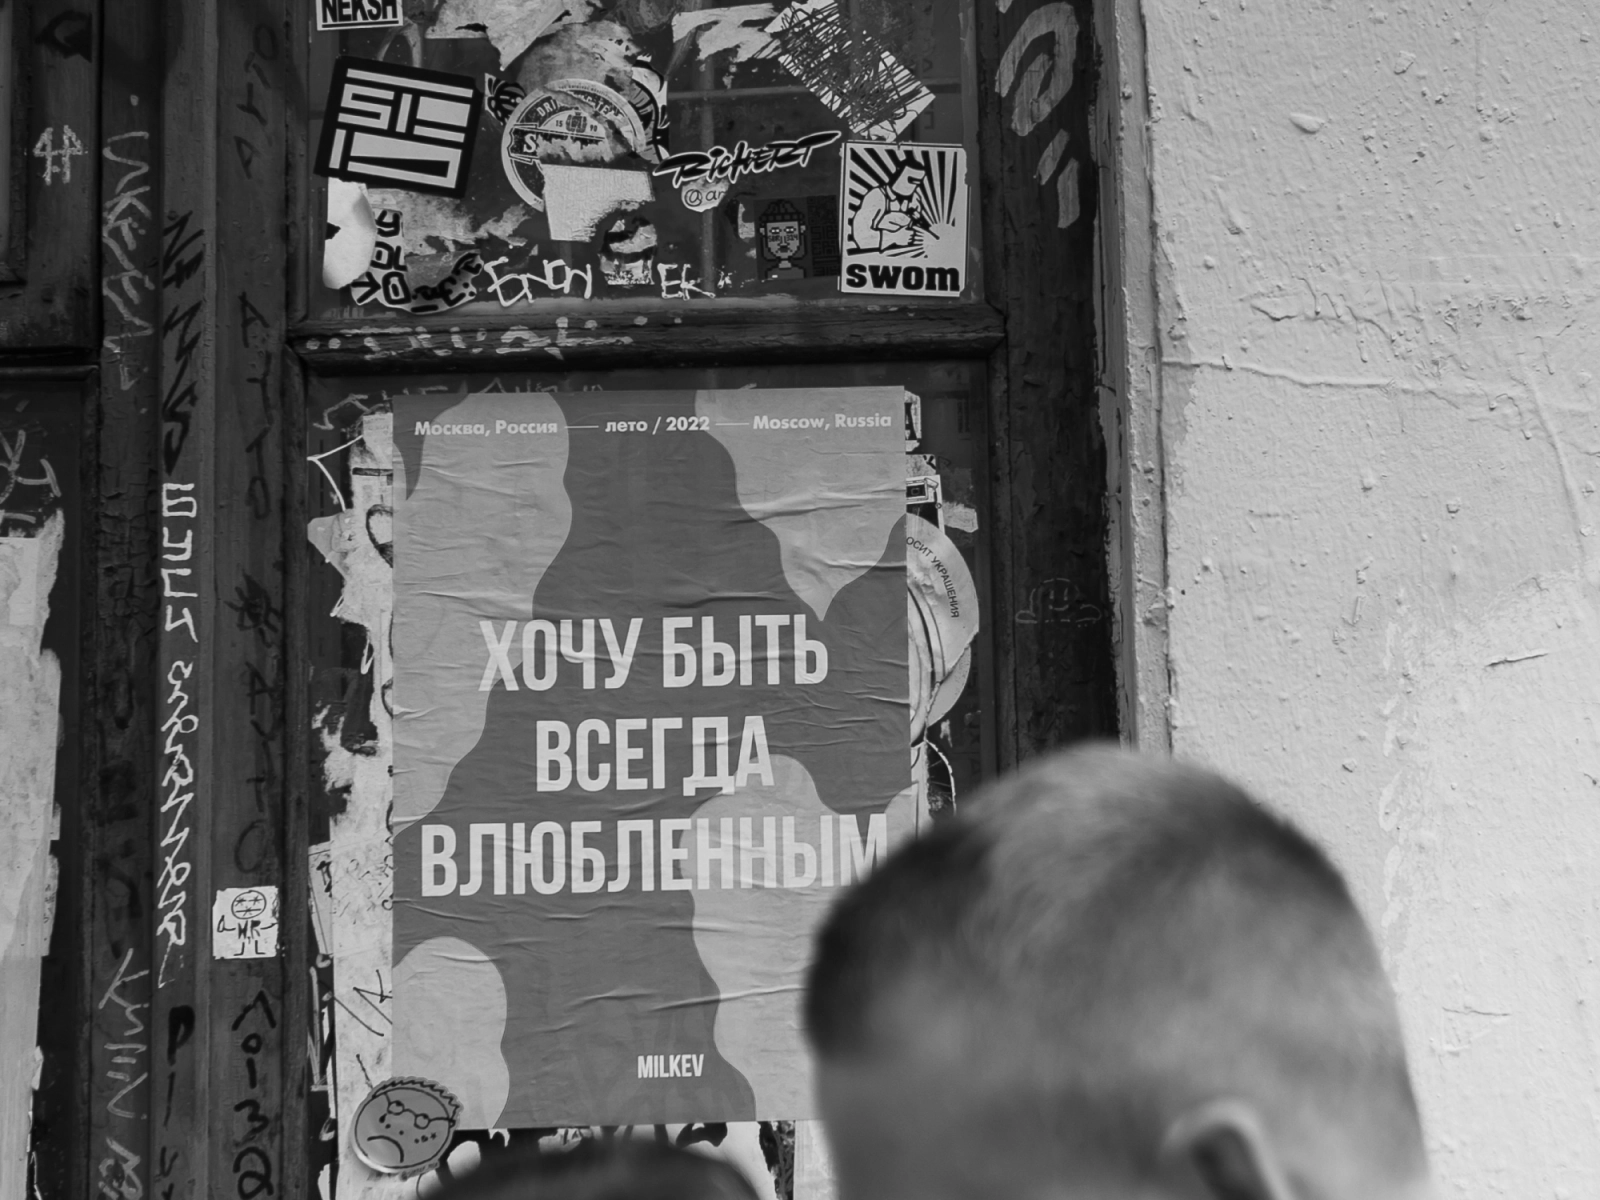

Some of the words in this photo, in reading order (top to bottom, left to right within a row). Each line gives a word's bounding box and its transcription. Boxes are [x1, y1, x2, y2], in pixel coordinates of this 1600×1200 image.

[414, 420, 491, 437] Москва,
[495, 419, 558, 435] Россия
[605, 420, 648, 433] лето
[666, 416, 710, 431] 2022
[753, 415, 830, 431] Moscow,
[835, 413, 892, 428] Russia
[905, 536, 933, 558] ОСИТ
[931, 555, 960, 618] УКРАШЕНИЯ
[478, 617, 643, 691] ХОЧУ
[661, 614, 828, 689] БЫТЬ
[536, 715, 775, 796] ВСЕГДА
[420, 814, 888, 897] ВЛЮБЛЕННЫМ
[637, 1054, 704, 1079] MILKEV
